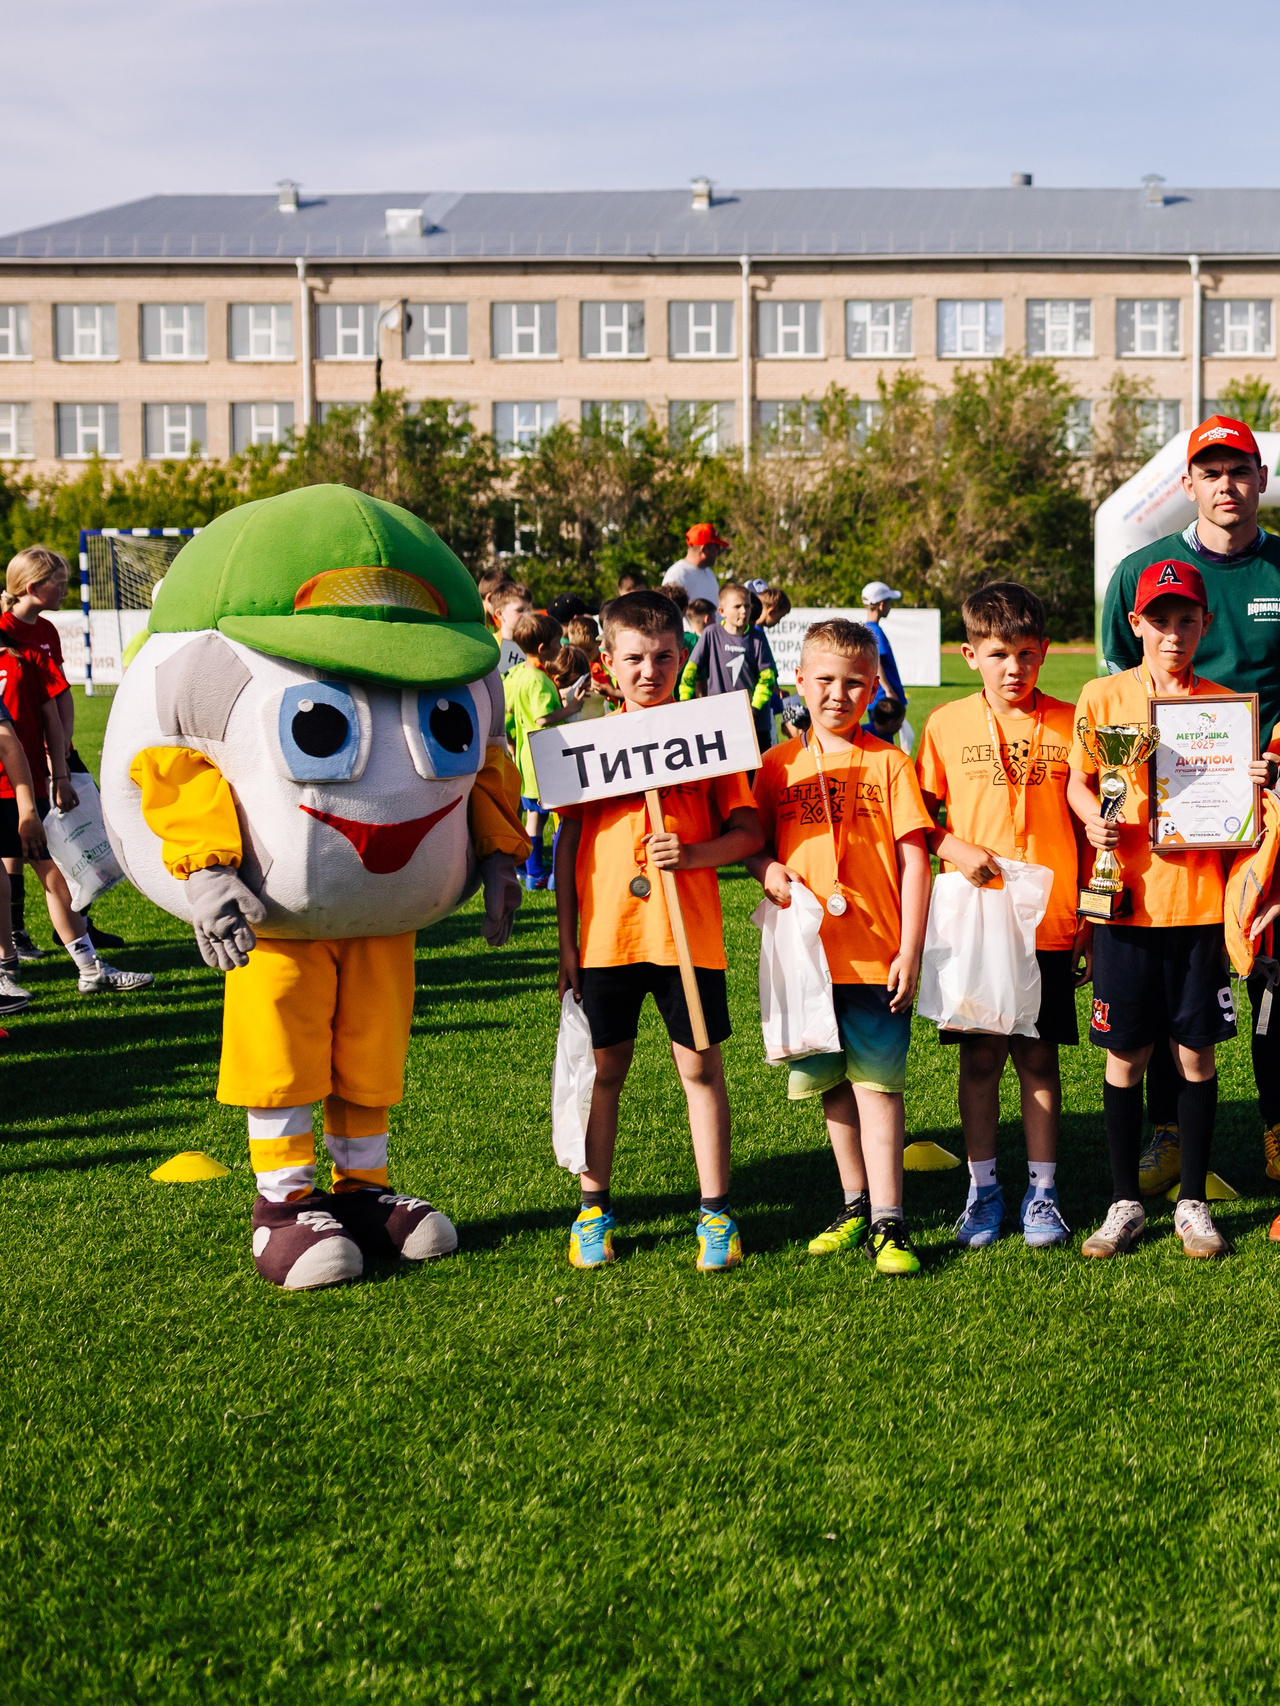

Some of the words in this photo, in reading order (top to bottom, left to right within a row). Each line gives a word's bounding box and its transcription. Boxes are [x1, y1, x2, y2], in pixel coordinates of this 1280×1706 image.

[1190, 739, 1215, 750] 2025
[561, 729, 728, 788] Титан
[1175, 755, 1233, 767] ДИПЛОМ
[1217, 986, 1235, 1022] 9
